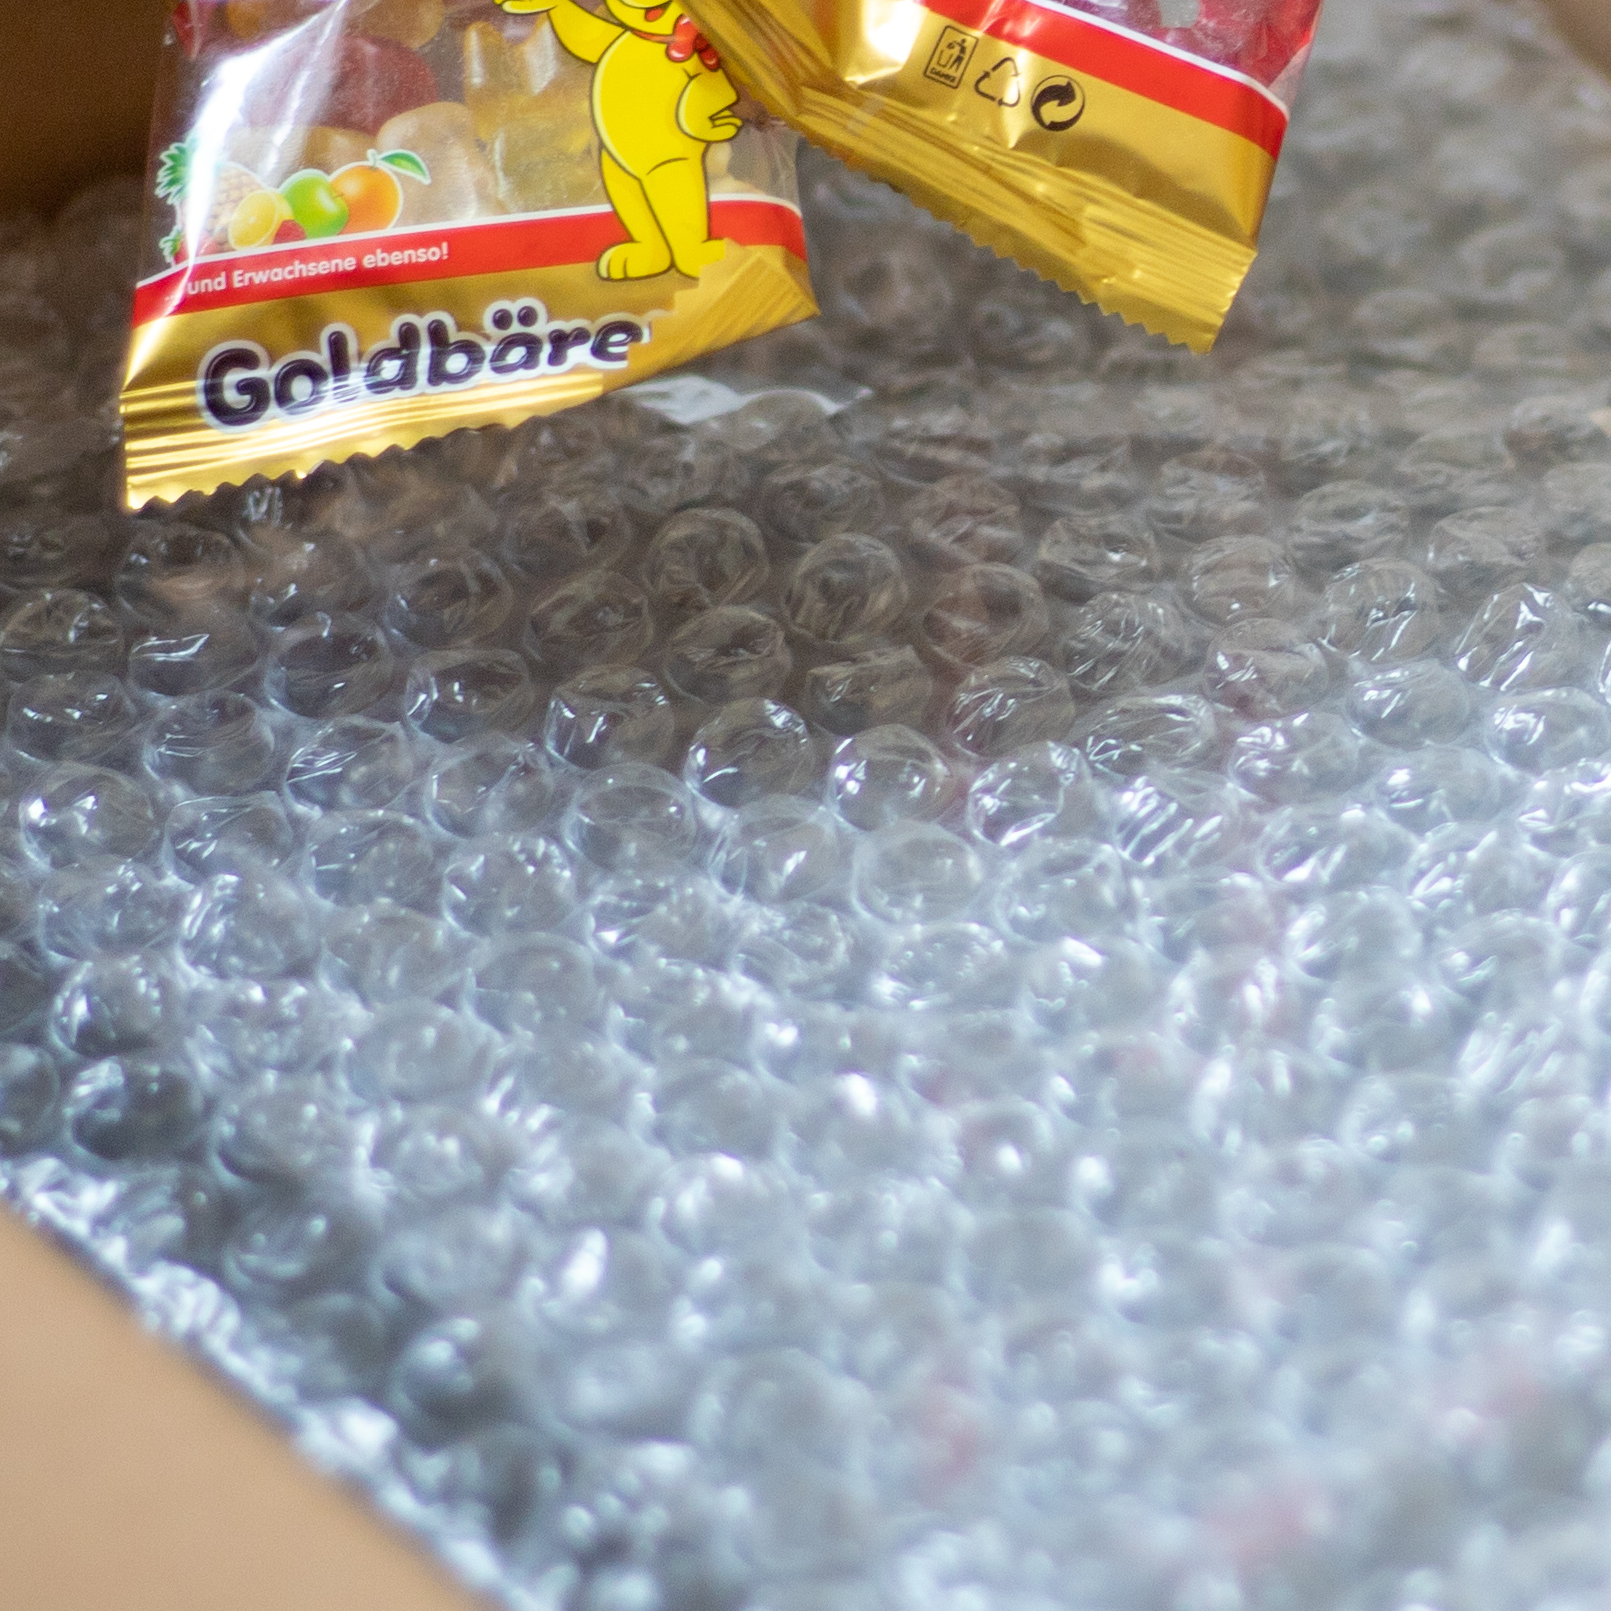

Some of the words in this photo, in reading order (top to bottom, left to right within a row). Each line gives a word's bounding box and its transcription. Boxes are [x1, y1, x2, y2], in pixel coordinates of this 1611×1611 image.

[187, 271, 227, 295] und
[233, 254, 358, 288] Erwachsene
[362, 241, 449, 269] ebenso!
[202, 304, 653, 427] Goldbäre
